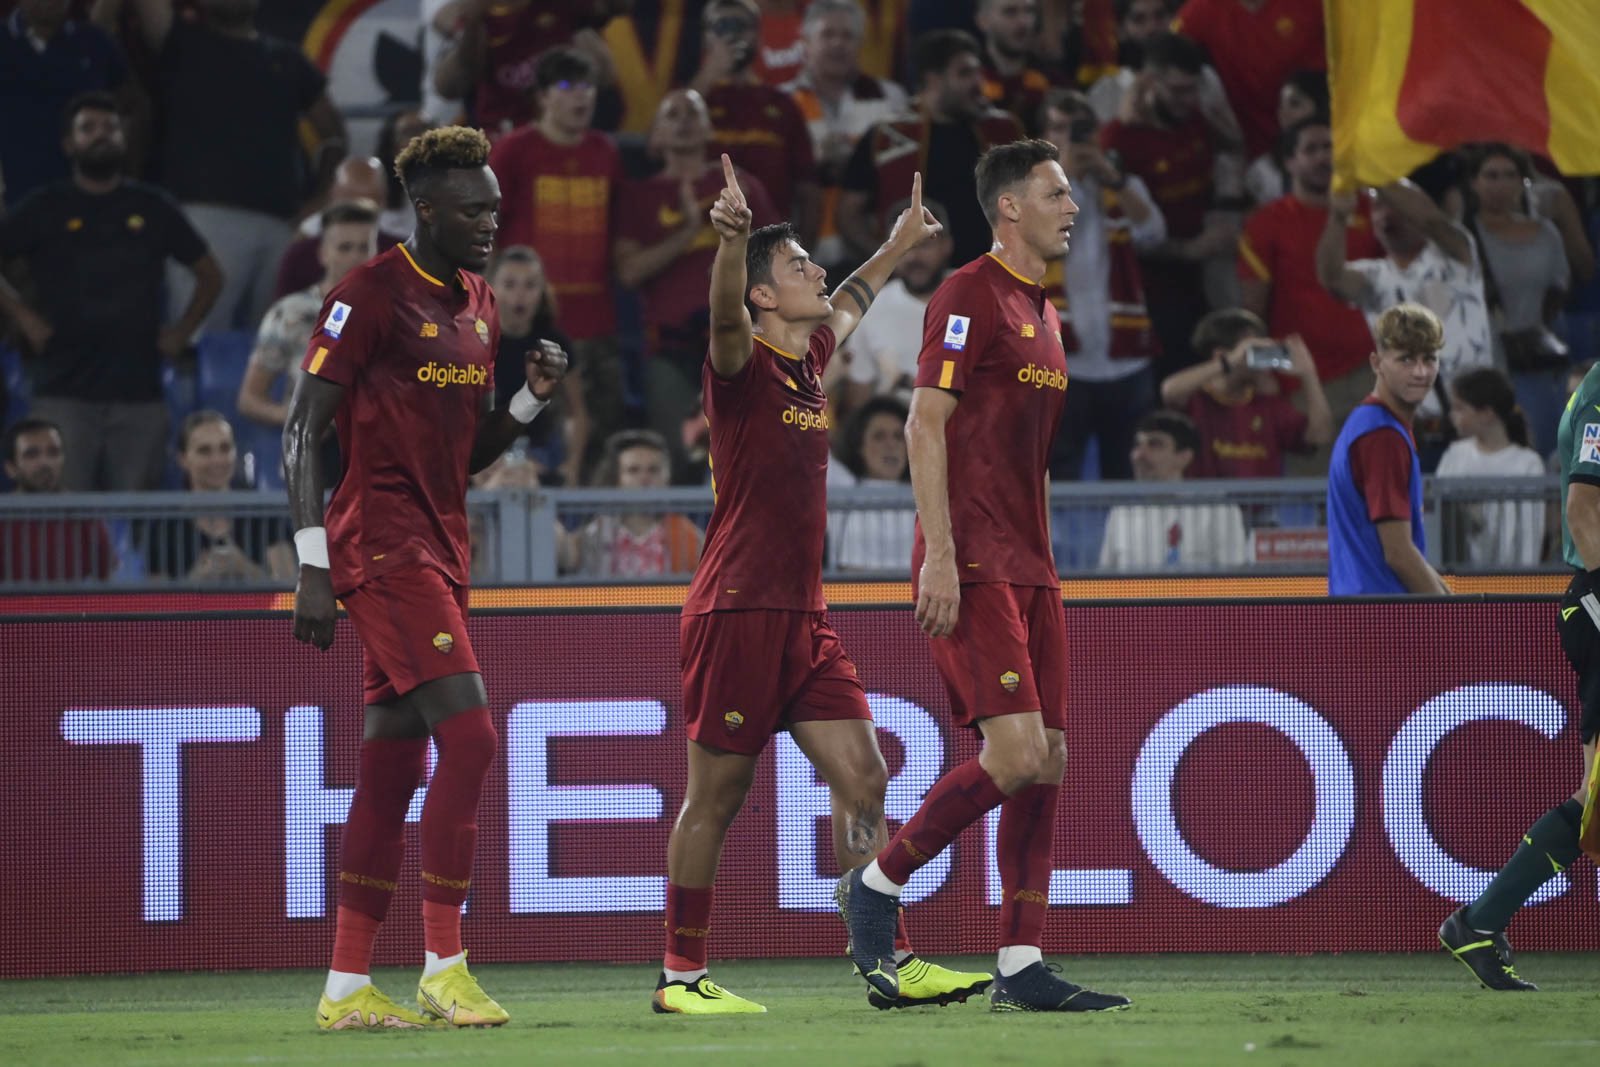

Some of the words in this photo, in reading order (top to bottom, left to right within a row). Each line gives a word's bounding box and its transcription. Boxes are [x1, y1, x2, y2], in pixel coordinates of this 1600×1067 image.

[417, 361, 488, 388] digitalbit
[60, 700, 667, 921] THE
[776, 682, 1600, 909] BLOC
